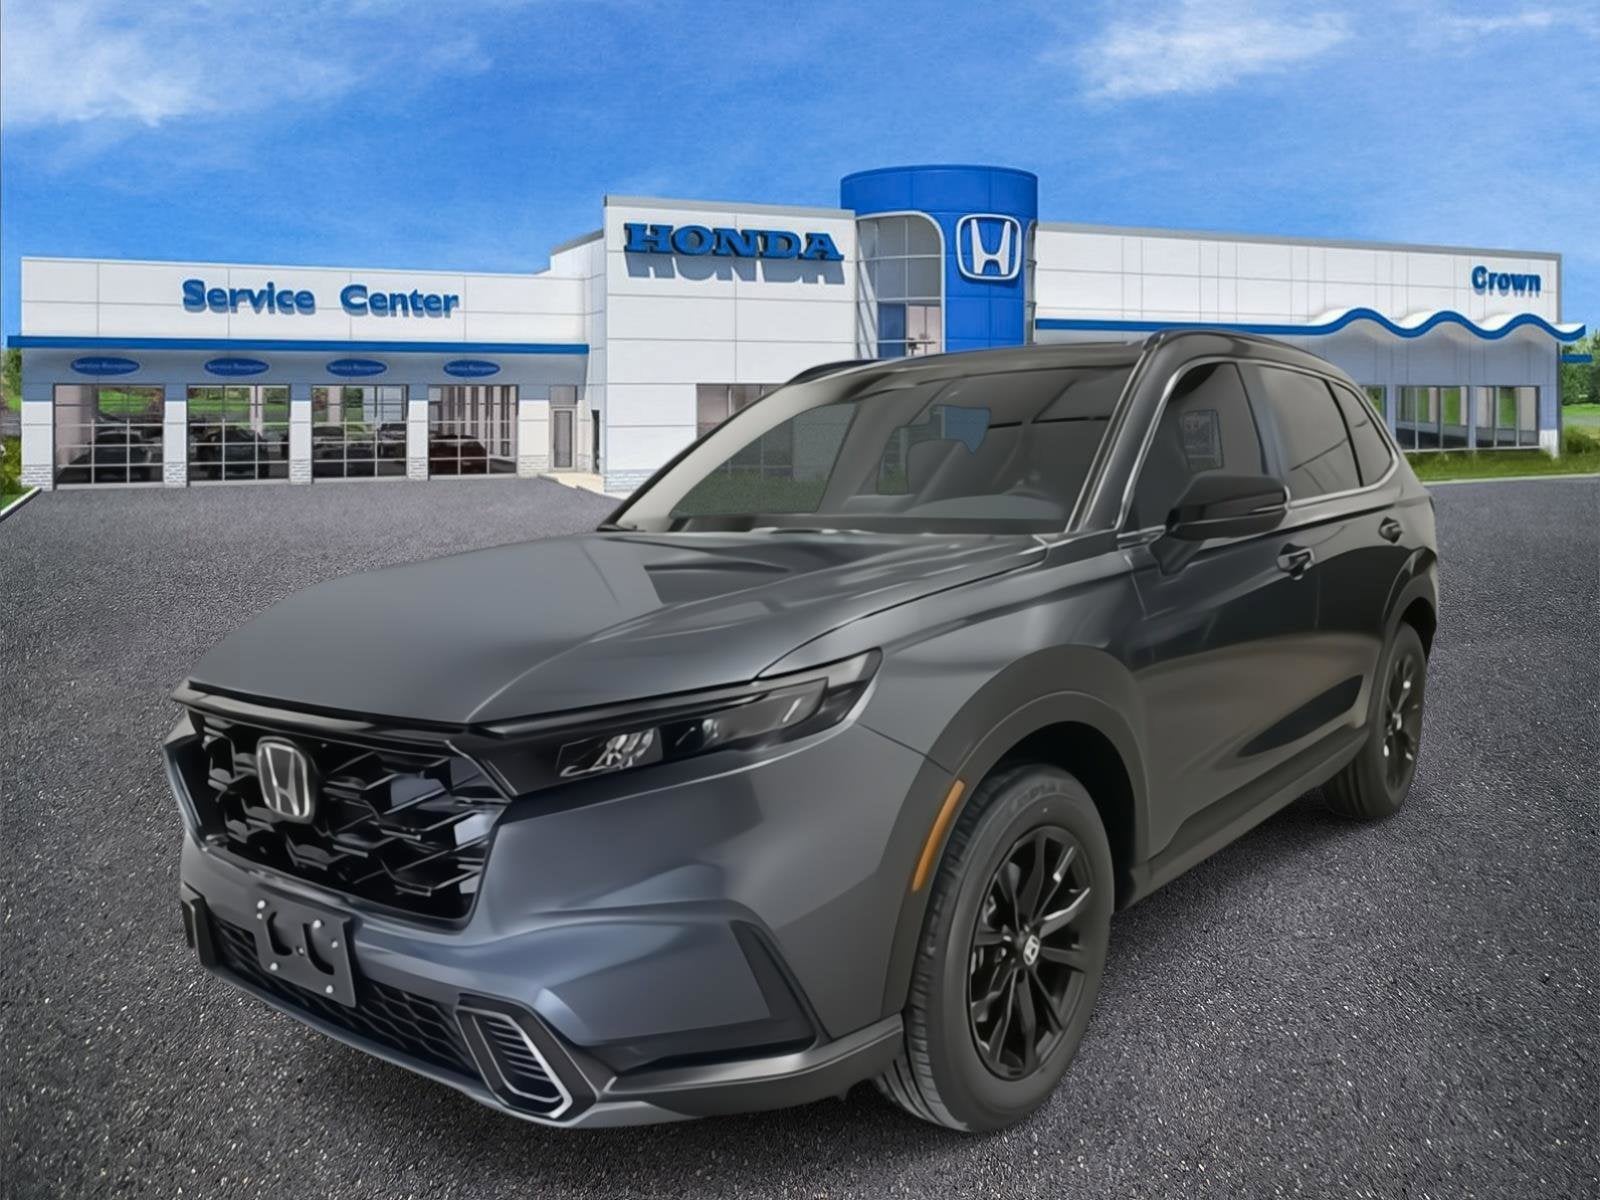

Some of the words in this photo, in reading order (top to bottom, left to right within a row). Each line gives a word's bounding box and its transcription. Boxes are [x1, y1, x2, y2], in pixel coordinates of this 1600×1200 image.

[624, 223, 844, 261] HONDA
[1472, 265, 1541, 291] Crown
[183, 279, 315, 311] Service
[340, 284, 459, 315] Center
